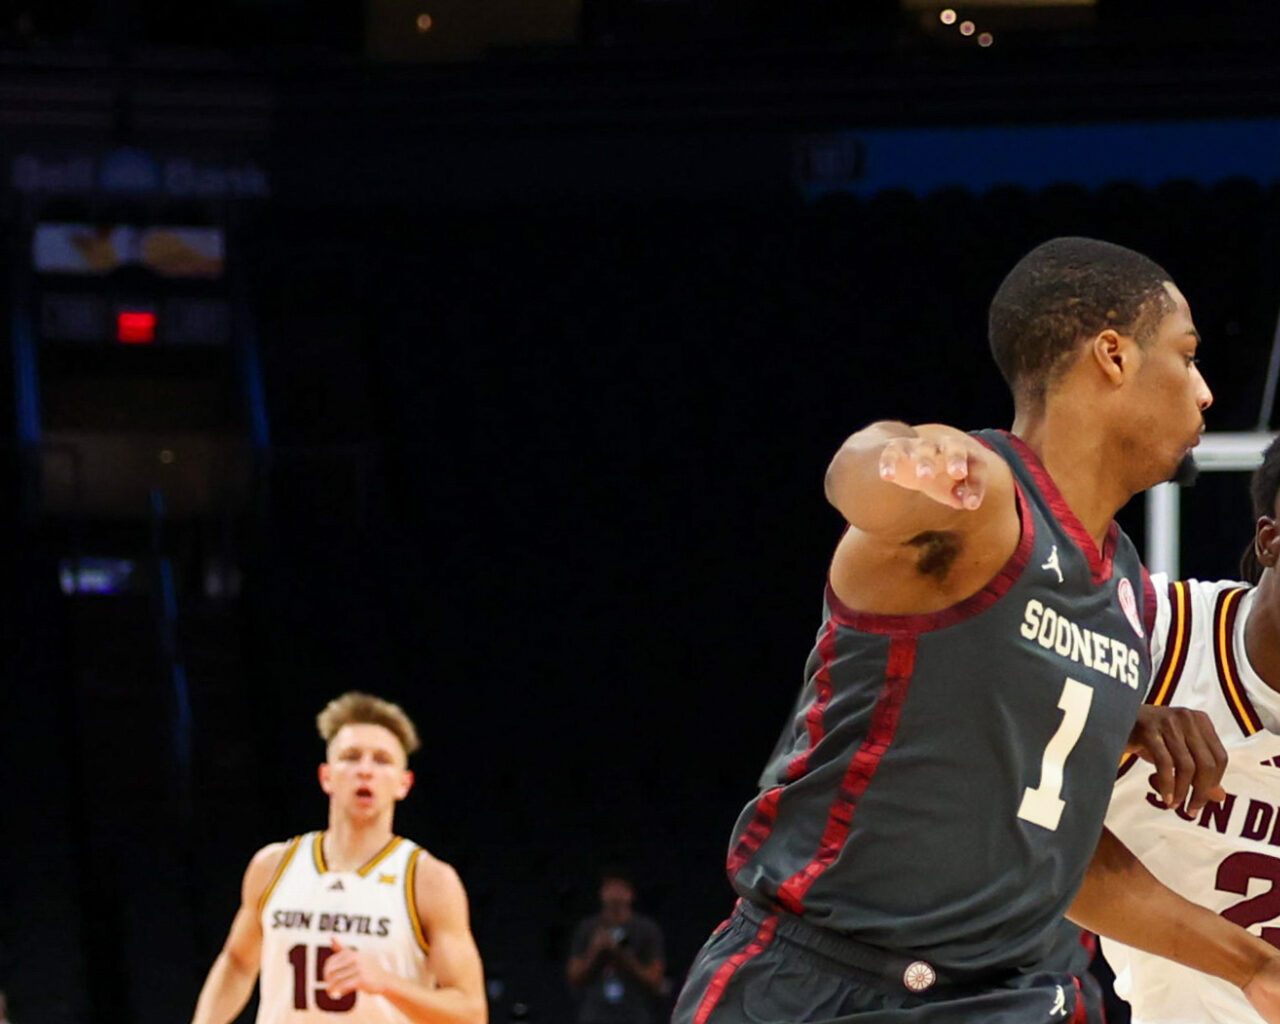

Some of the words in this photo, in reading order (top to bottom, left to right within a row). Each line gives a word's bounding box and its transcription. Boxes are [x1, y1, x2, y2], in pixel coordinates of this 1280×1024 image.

[1019, 598, 1141, 690] SOONERS
[1016, 676, 1095, 832] 1
[272, 909, 313, 930] SUN
[317, 912, 392, 938] DEVILS
